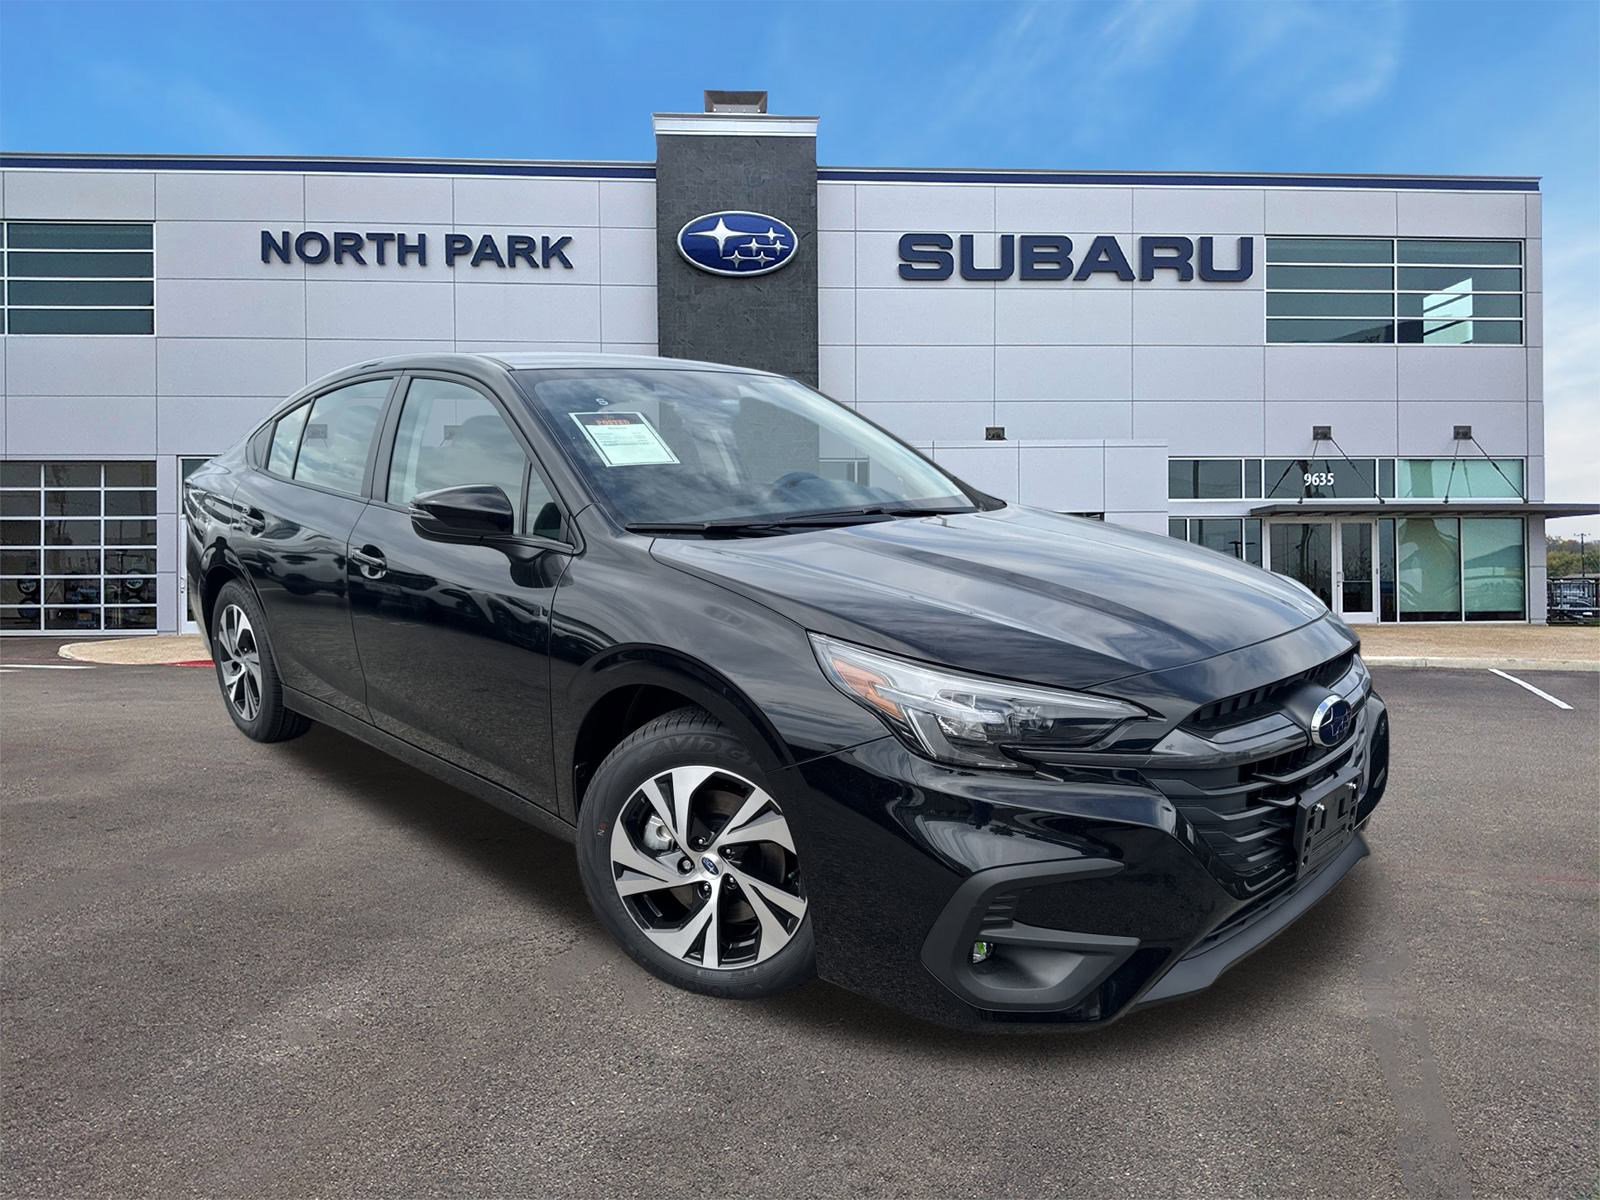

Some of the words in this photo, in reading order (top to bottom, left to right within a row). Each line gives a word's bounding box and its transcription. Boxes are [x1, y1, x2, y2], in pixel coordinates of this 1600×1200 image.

[261, 230, 427, 267] NORTH
[444, 232, 574, 269] PARK
[898, 232, 1254, 282] SUBARU
[1303, 472, 1335, 486] 9635
